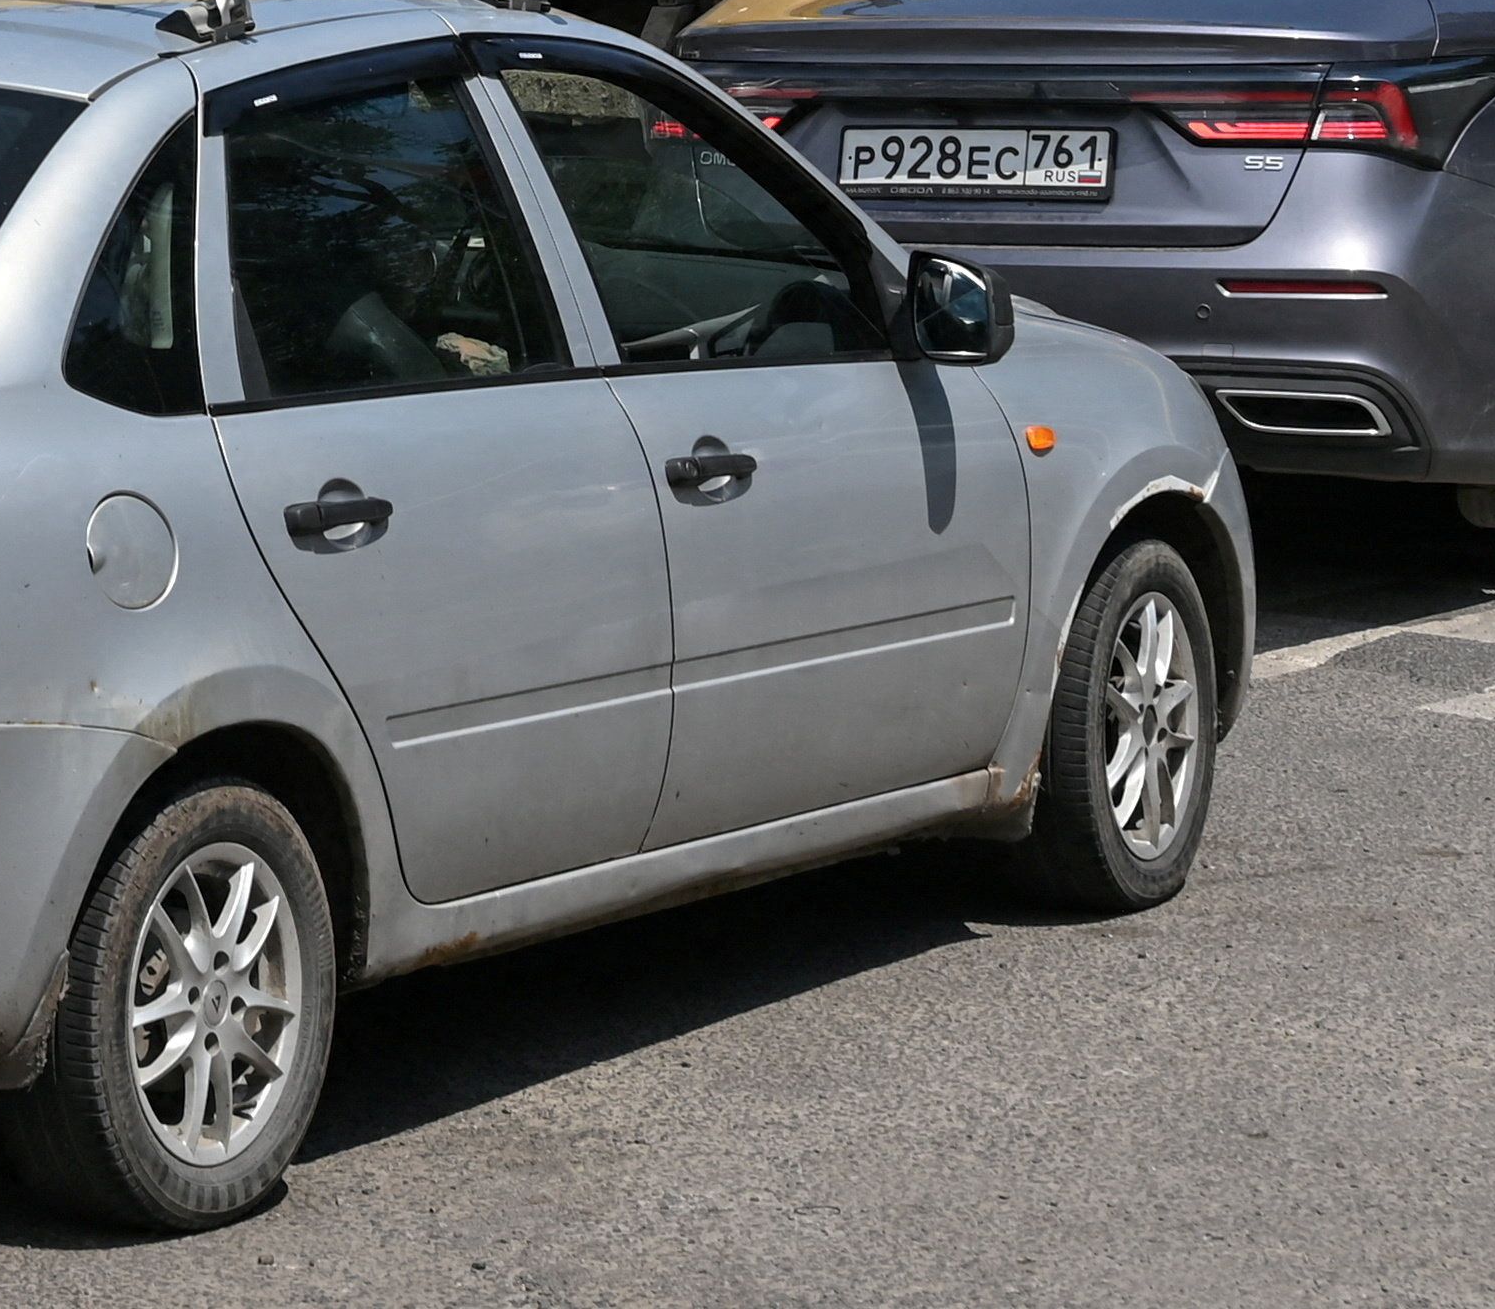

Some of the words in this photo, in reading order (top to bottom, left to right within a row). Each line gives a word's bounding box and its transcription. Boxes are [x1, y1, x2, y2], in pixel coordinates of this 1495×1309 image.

[853, 134, 1020, 181] Р928ЕС
[1031, 133, 1098, 171] 761
[1244, 155, 1284, 171] S5
[1044, 169, 1076, 183] RUS
